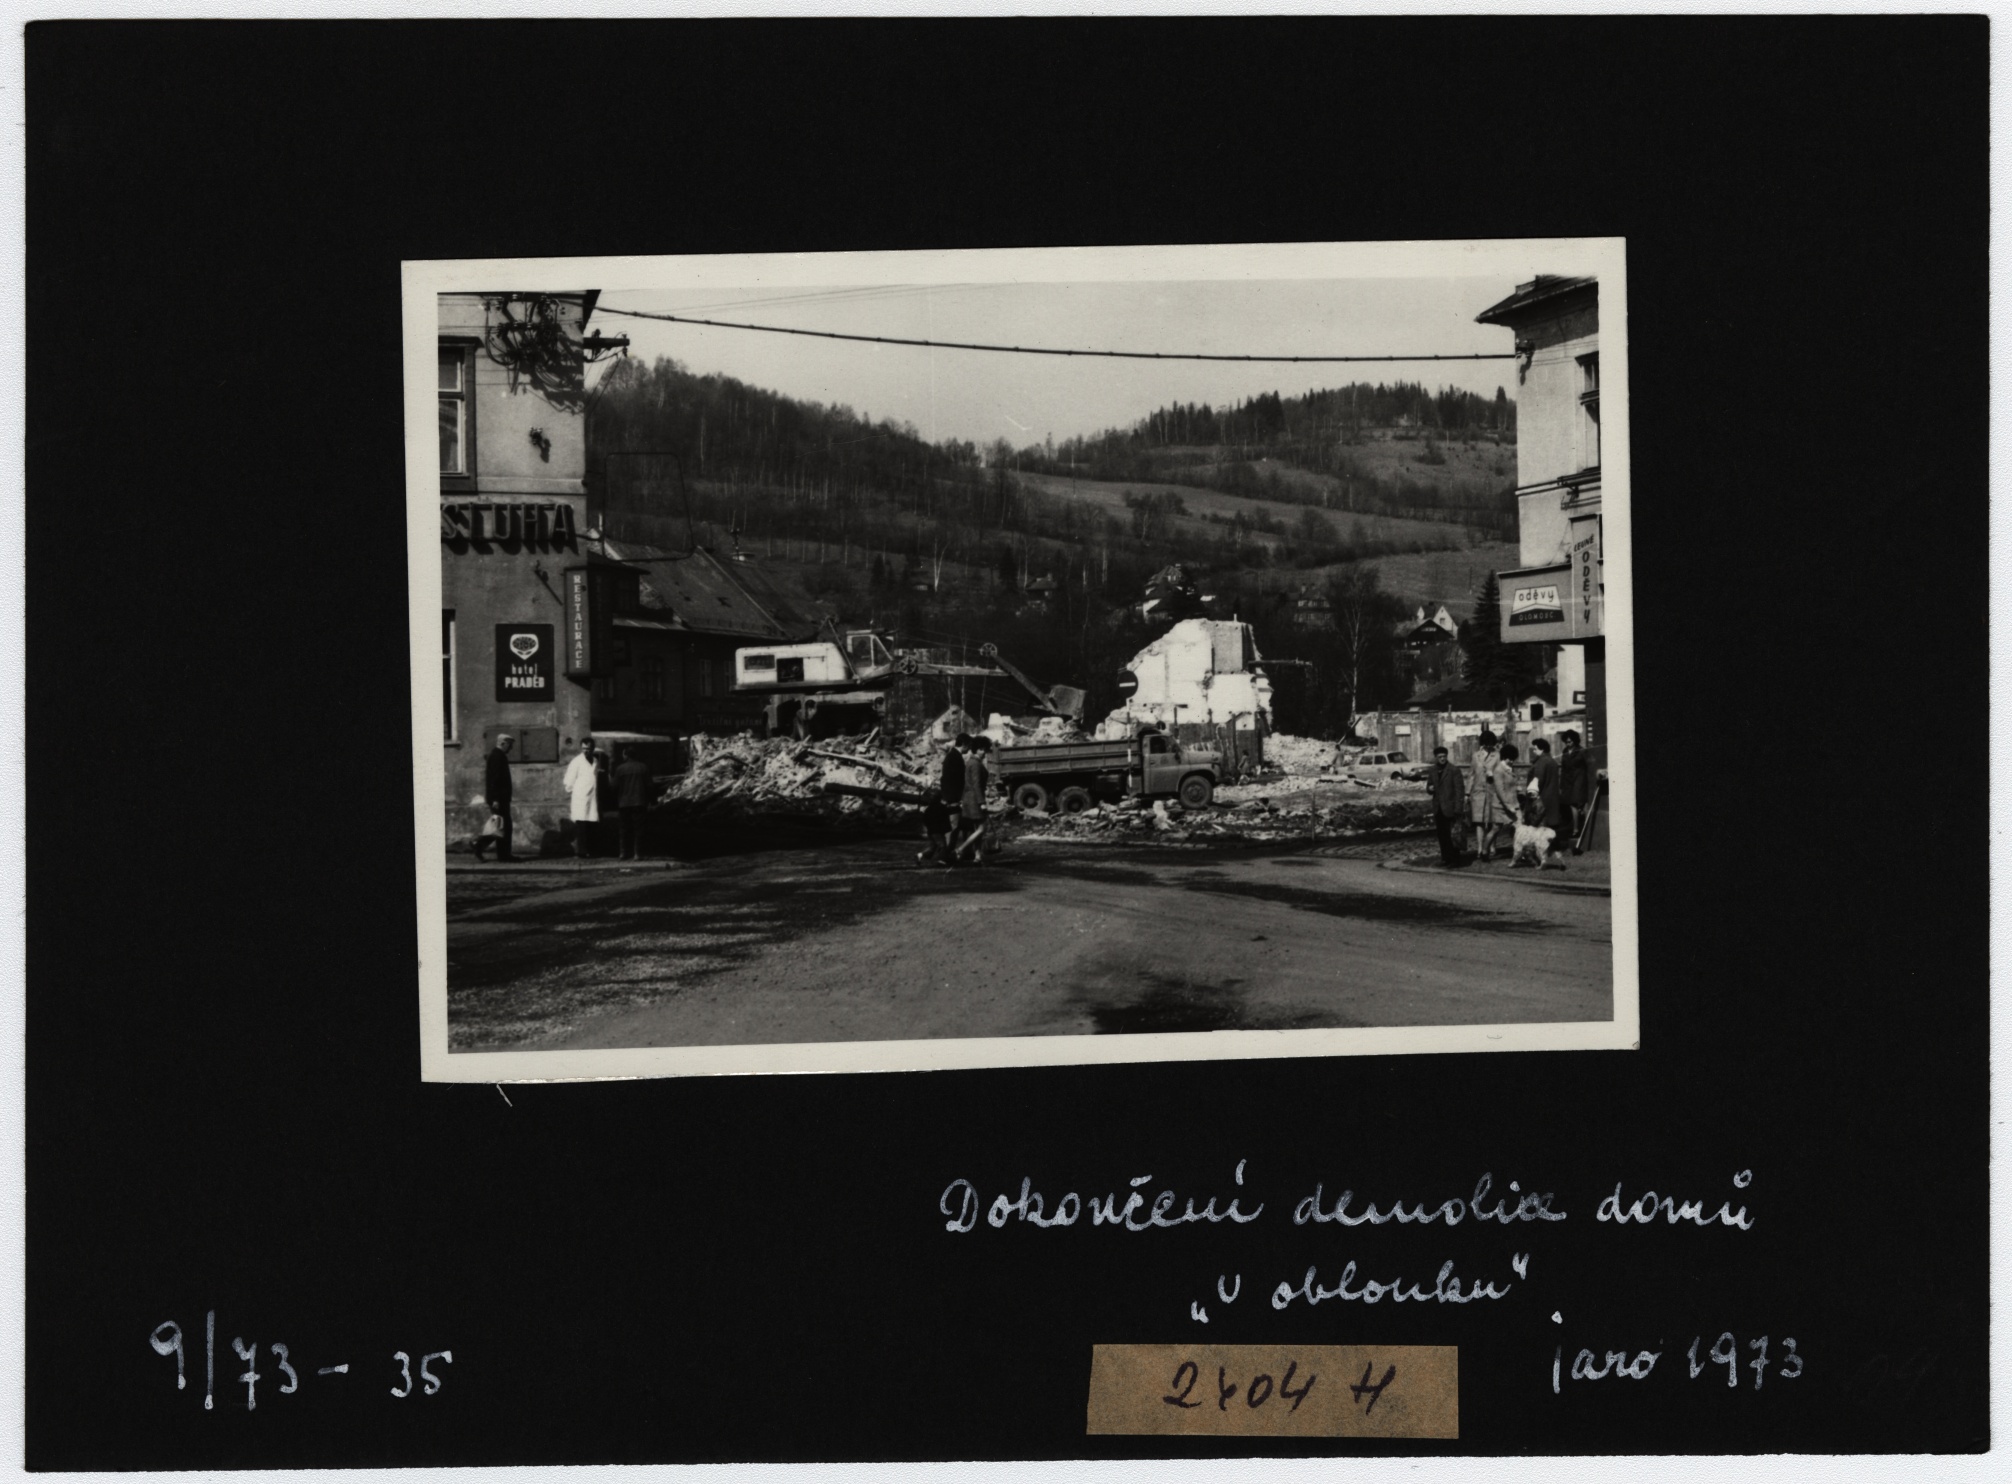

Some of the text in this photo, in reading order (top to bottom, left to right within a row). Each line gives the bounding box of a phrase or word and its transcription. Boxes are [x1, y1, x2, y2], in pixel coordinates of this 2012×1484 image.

[1519, 611, 1554, 621] OLOMOUC
[1582, 551, 1590, 623] ODĚVY
[572, 573, 583, 669] RESTAURACE
[511, 663, 538, 676] hotel
[939, 1158, 1264, 1233] Dokončení
[1596, 1169, 1755, 1231] domů
[390, 1350, 453, 1398] 35
[1551, 1310, 1662, 1394] jaro
[1687, 1331, 1805, 1390] 1973
[1349, 1360, 1397, 1415] H
